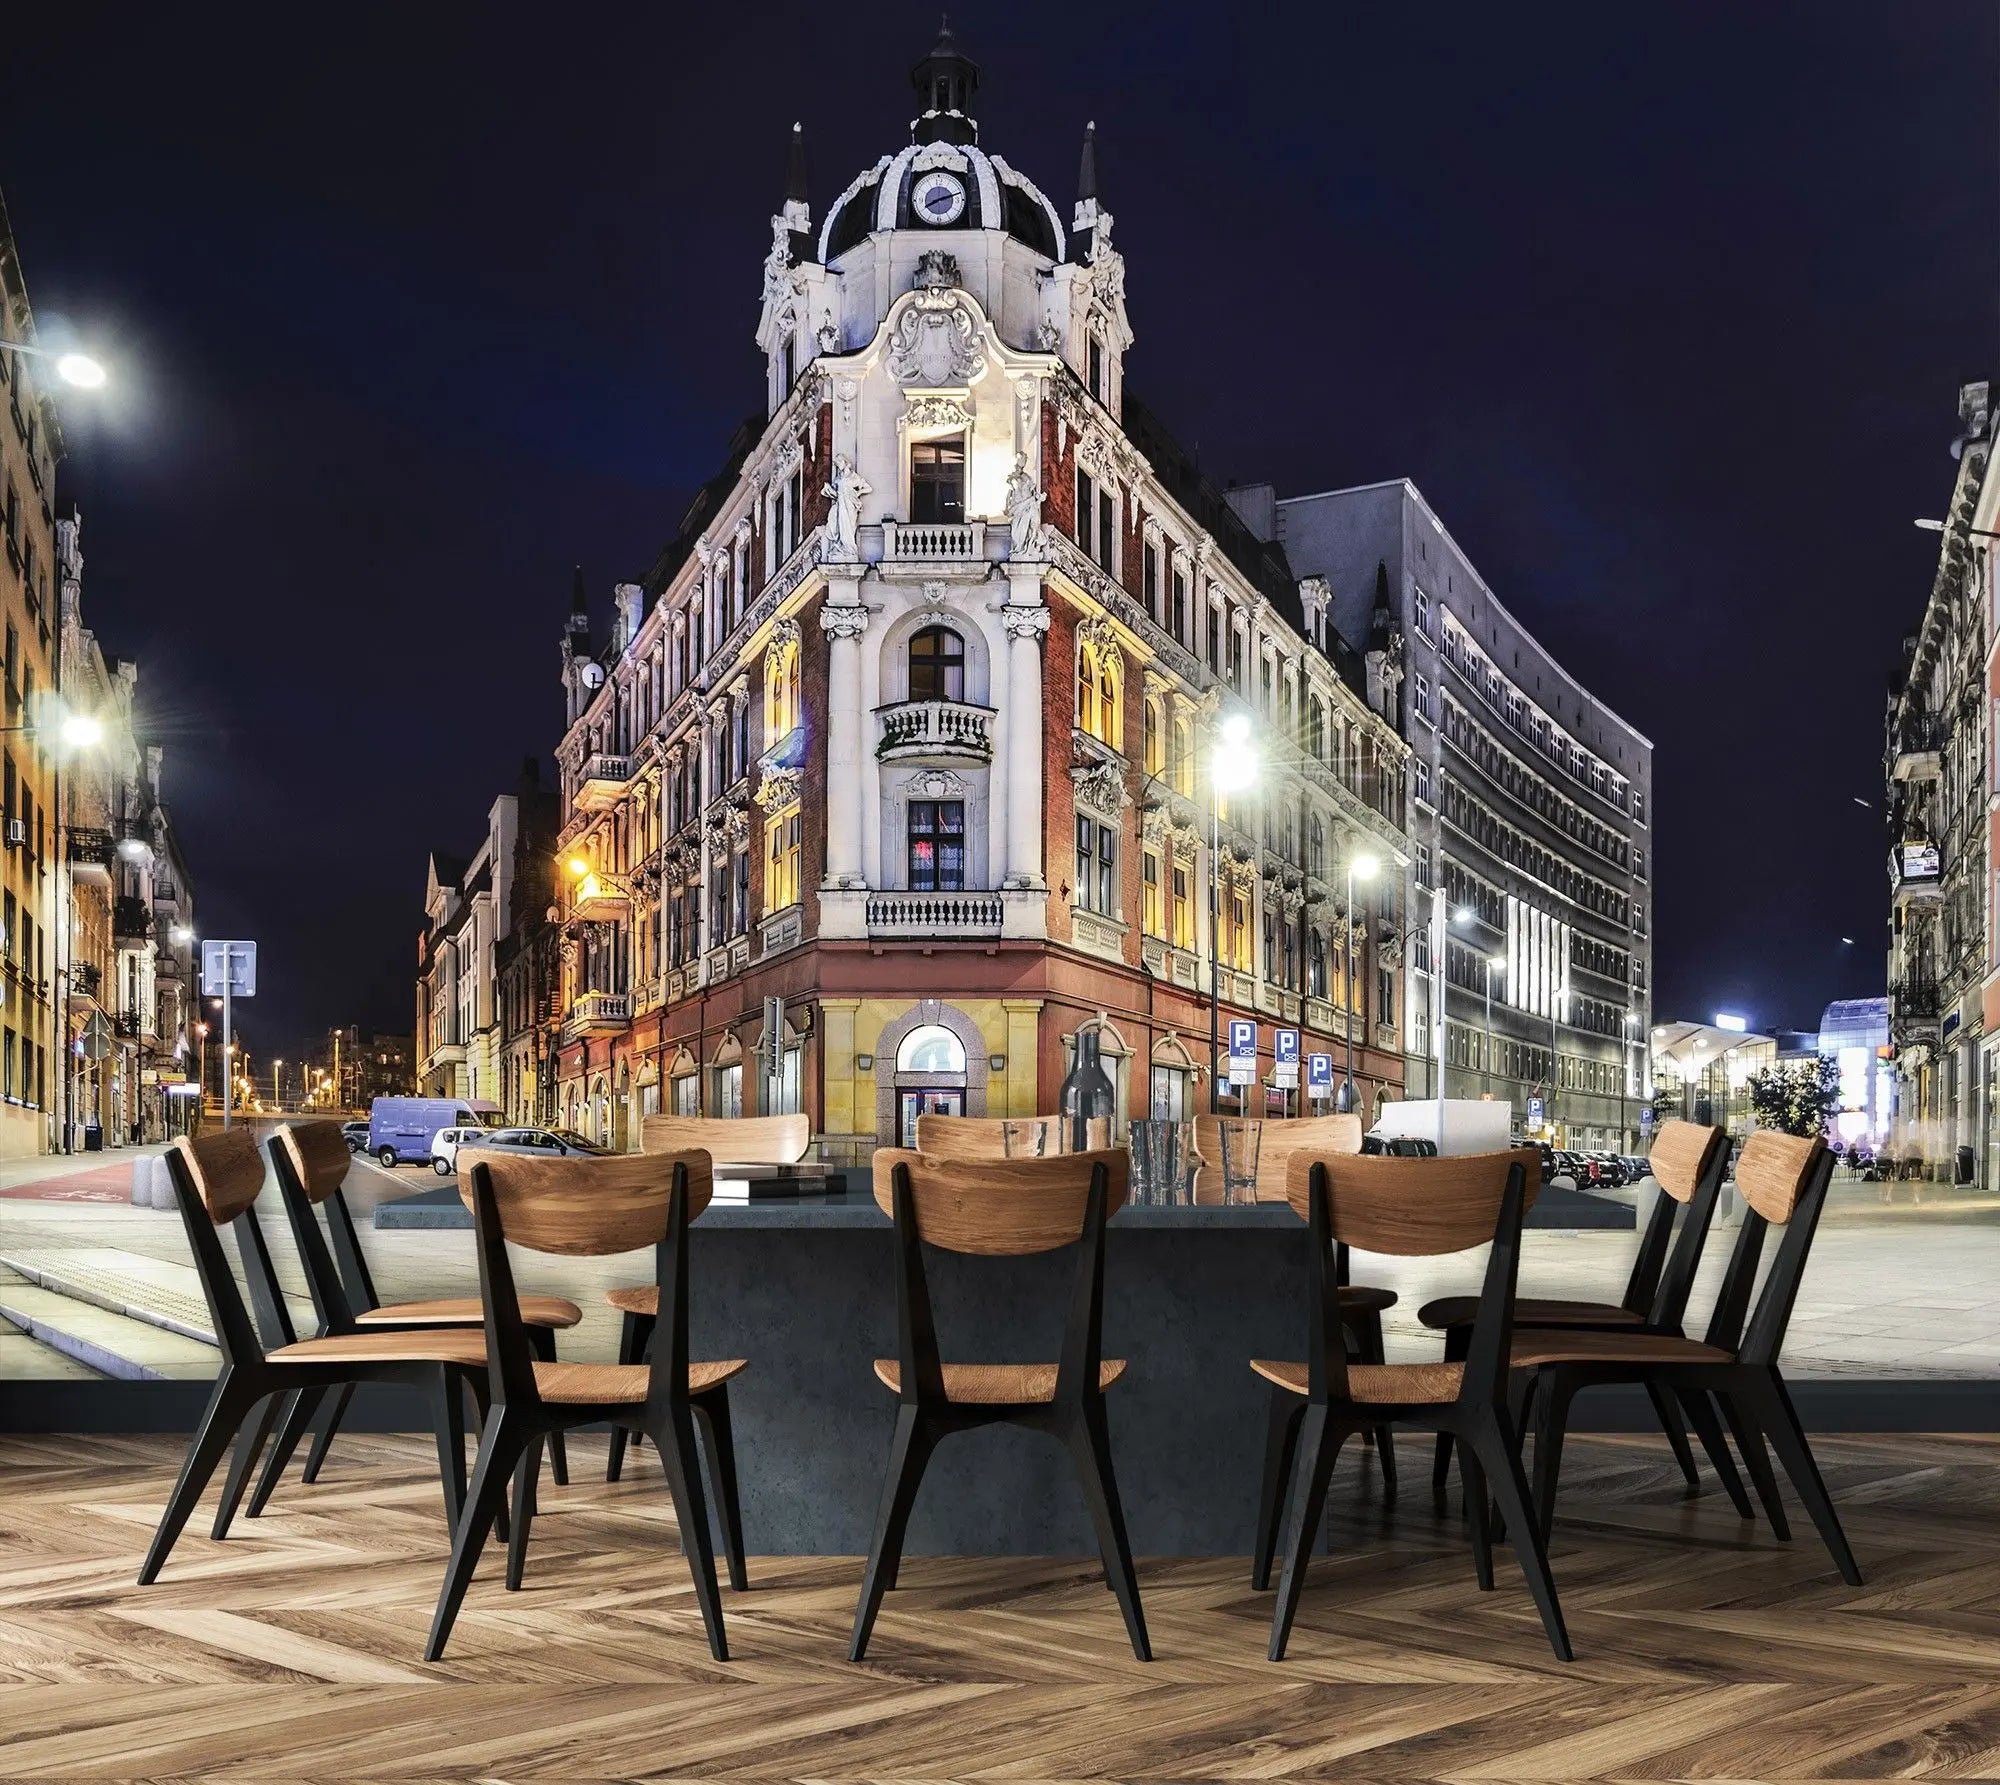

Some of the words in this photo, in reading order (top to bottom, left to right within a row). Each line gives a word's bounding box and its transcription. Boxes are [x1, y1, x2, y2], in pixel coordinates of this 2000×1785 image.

[1235, 1024, 1251, 1048] P
[1280, 1032, 1294, 1054] P
[1313, 1057, 1326, 1077] P
[1531, 1100, 1540, 1111] P
[1642, 1110, 1650, 1120] P
